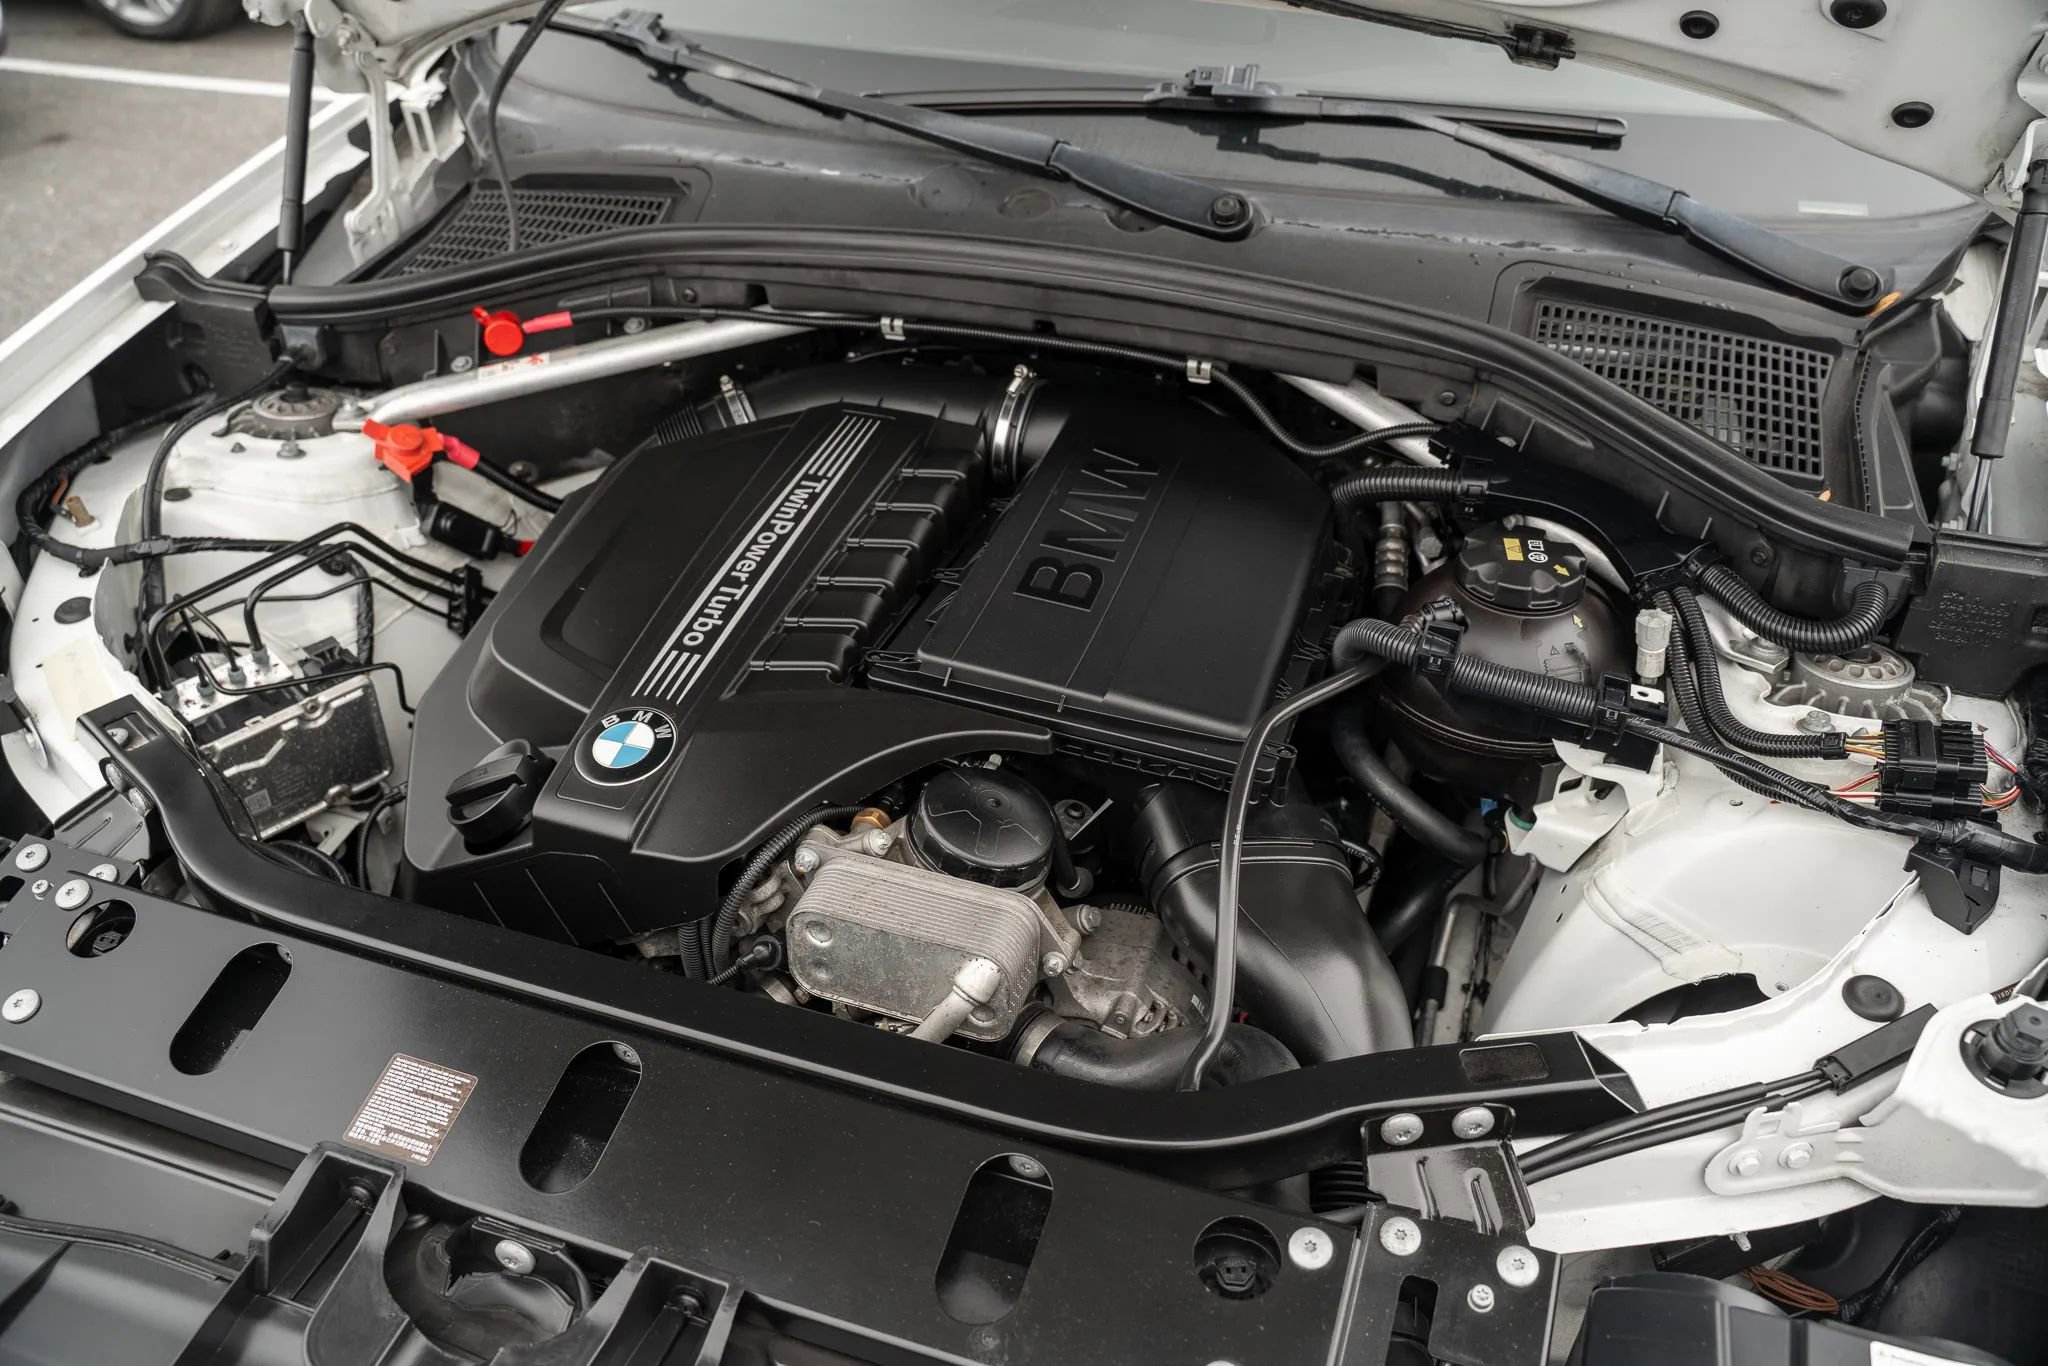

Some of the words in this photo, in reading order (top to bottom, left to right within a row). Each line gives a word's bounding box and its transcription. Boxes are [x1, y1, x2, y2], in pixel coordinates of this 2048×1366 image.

[730, 479, 828, 582] TwinPower
[1013, 448, 1158, 612] BMW
[682, 584, 749, 646] Turbo
[601, 710, 673, 739] BMW
